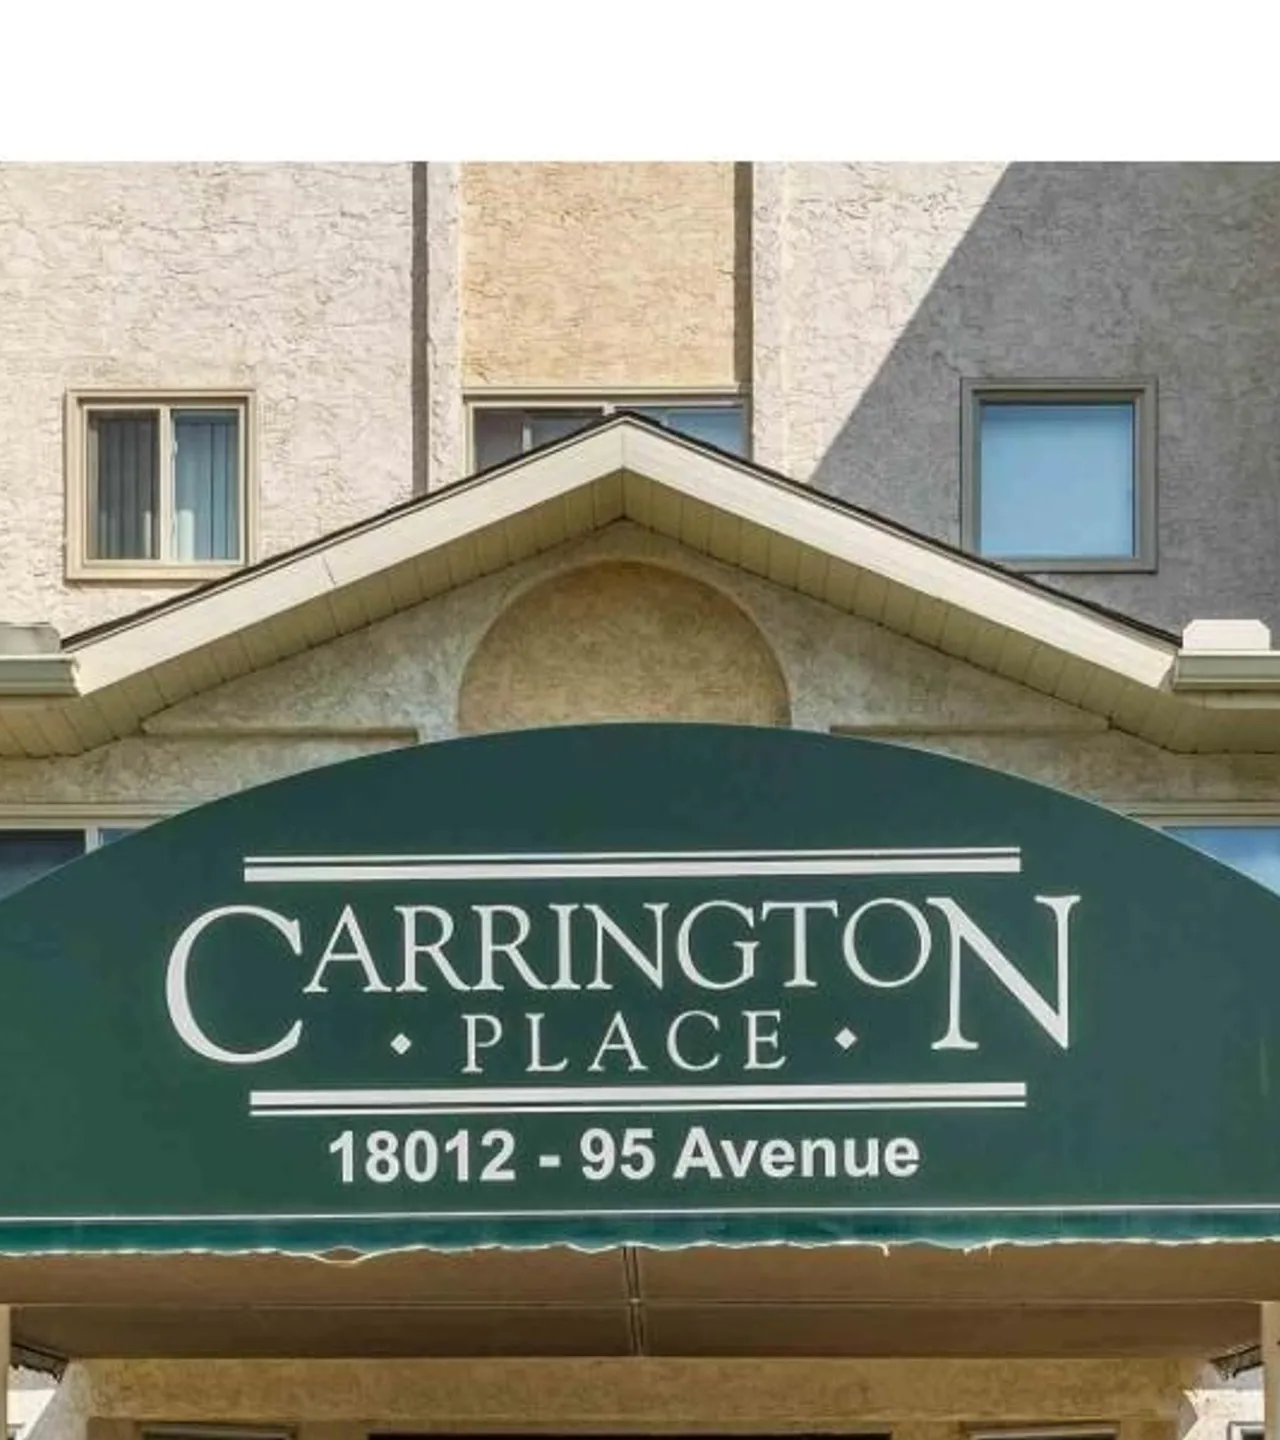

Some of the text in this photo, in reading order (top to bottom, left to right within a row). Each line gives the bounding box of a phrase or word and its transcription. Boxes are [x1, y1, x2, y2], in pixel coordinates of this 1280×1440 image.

[165, 894, 1081, 1064] CARRINGTON
[461, 1010, 786, 1073] PLACE
[329, 1126, 920, 1183] 18012 - 95 Avenue
